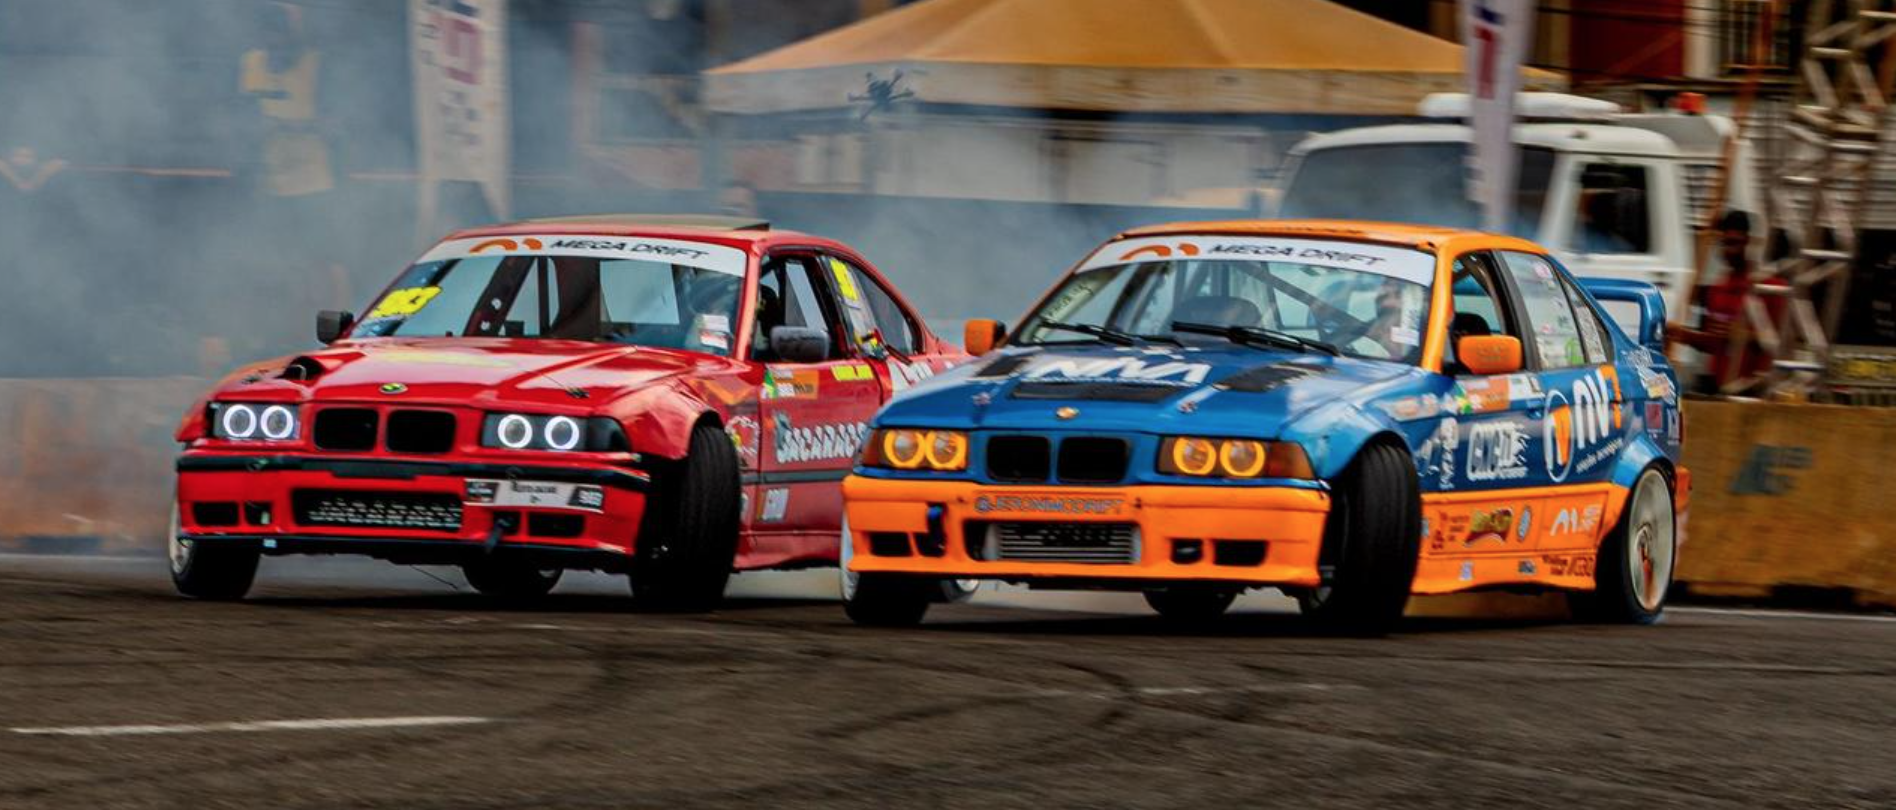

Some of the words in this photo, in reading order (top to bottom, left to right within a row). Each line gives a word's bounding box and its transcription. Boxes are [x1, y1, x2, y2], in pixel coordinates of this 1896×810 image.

[549, 239, 626, 252] MEGA
[631, 242, 708, 258] DRIFT
[1208, 244, 1293, 257] MEGA
[1299, 247, 1386, 265] DRIFT
